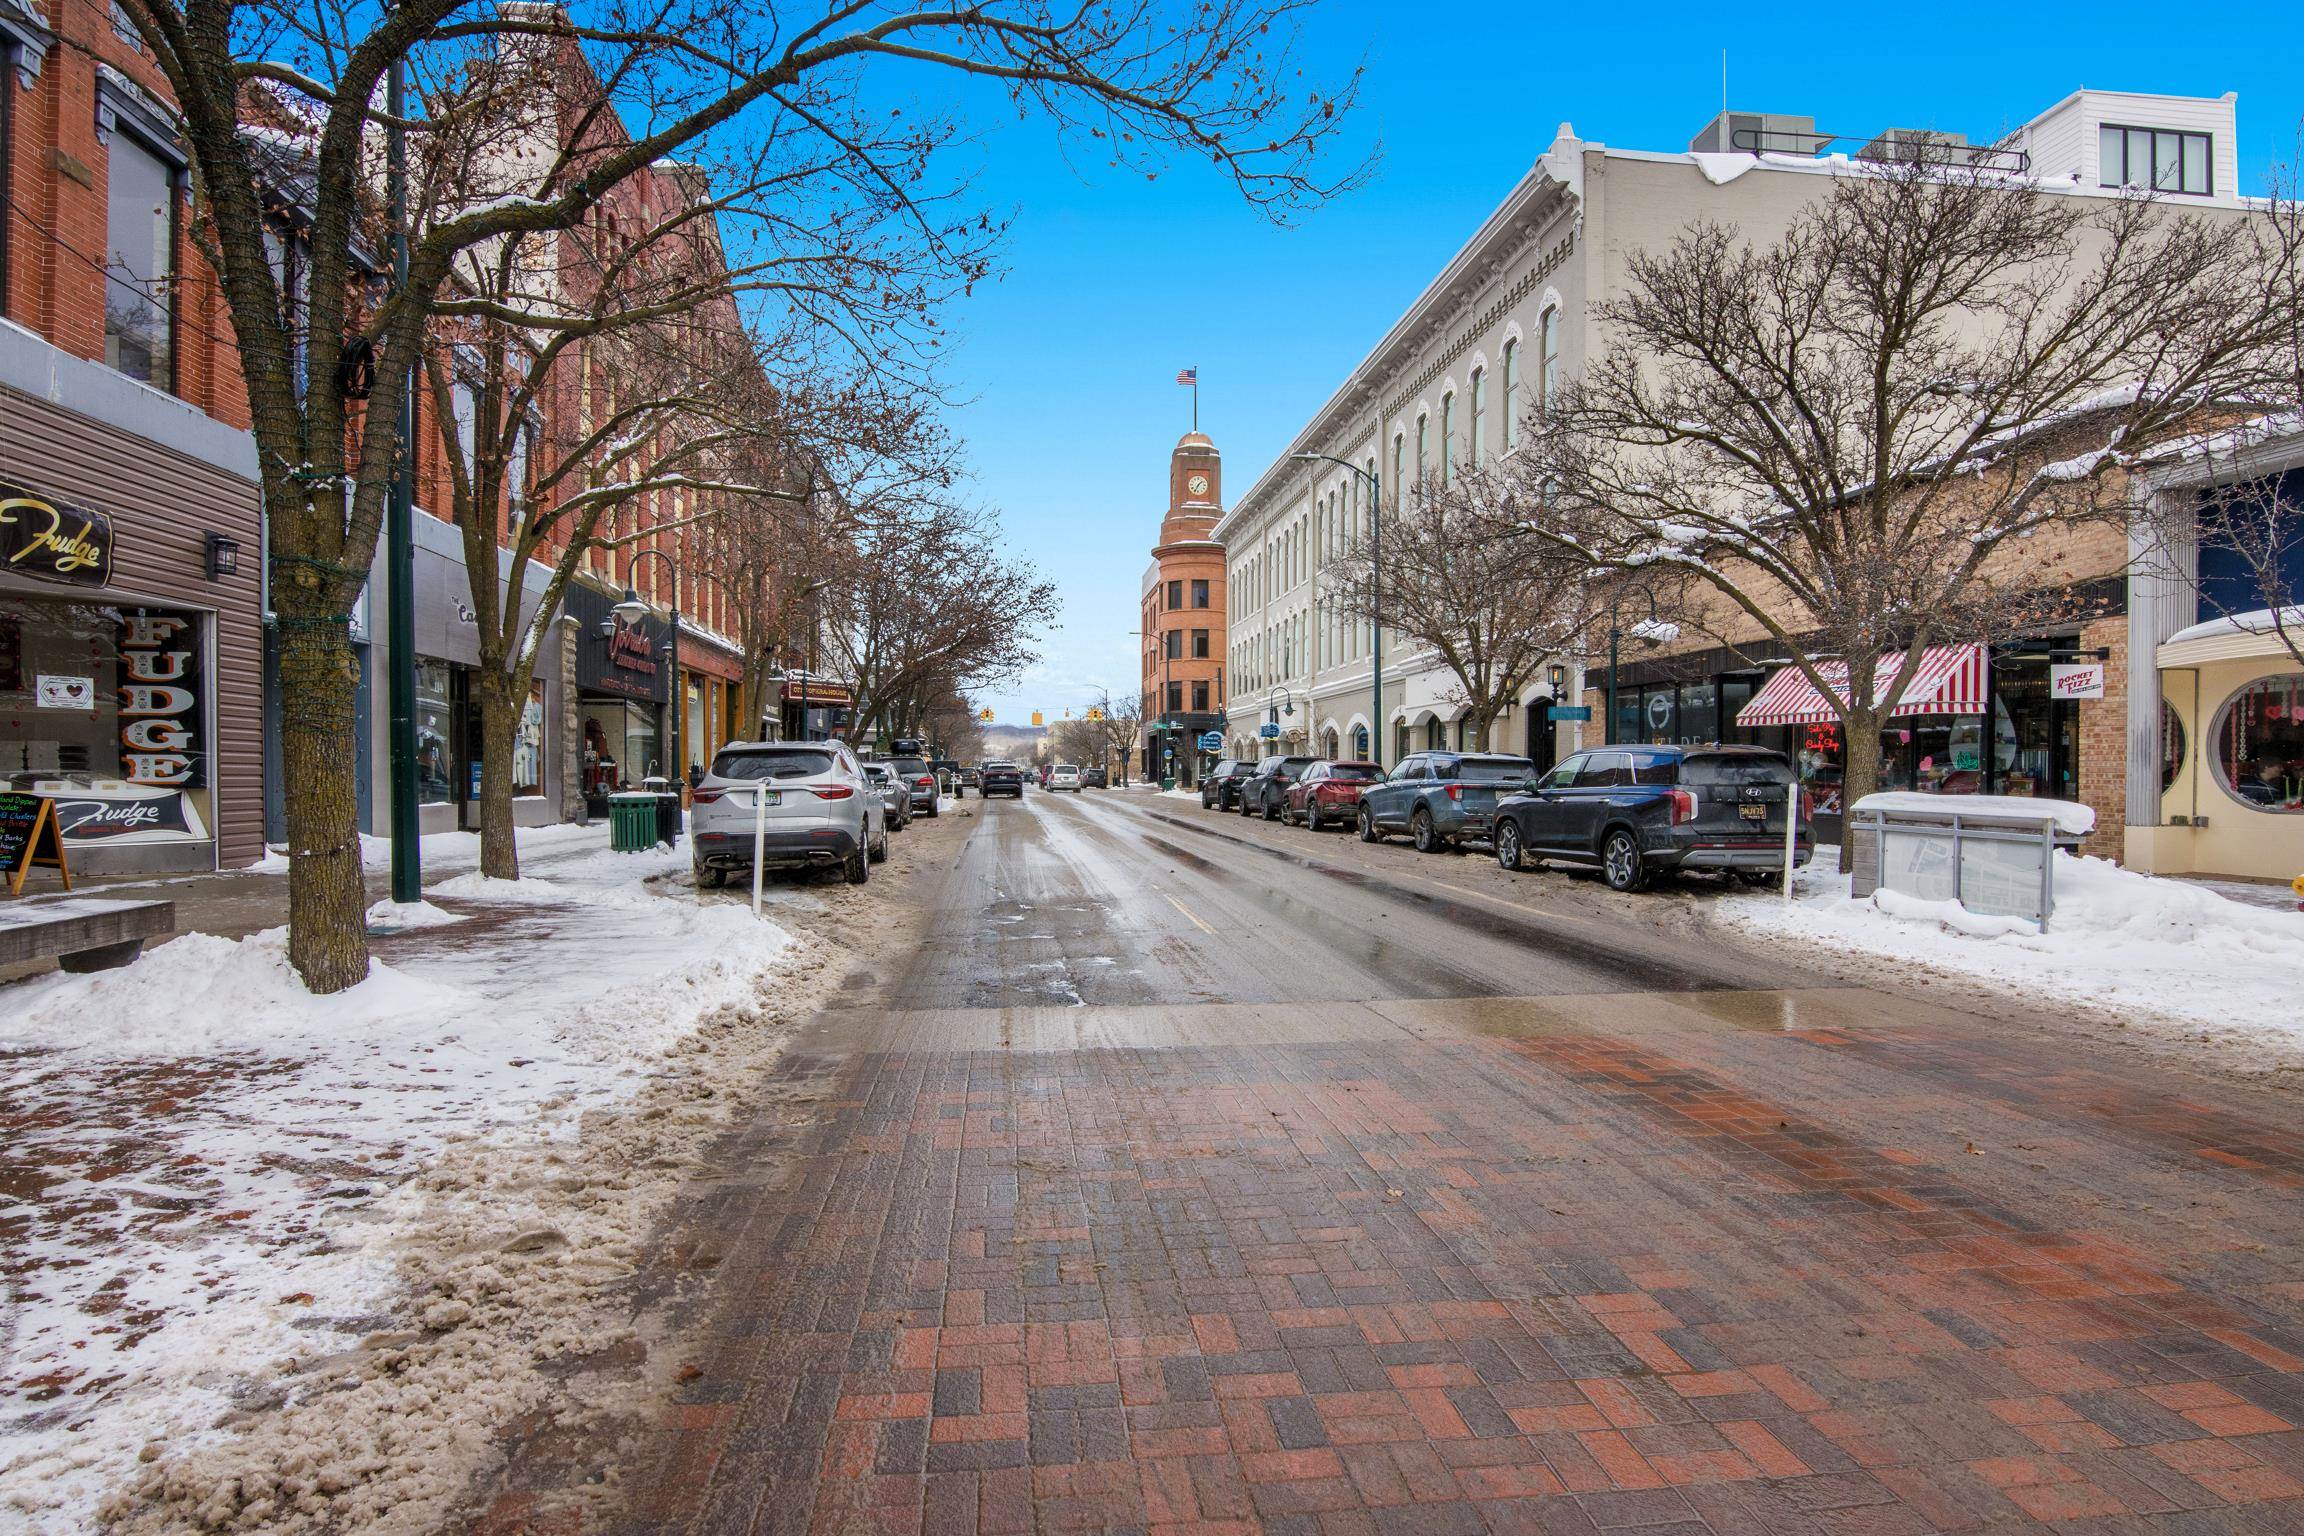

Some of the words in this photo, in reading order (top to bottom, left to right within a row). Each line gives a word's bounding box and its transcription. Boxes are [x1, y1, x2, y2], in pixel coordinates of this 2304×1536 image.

[2056, 671, 2094, 690] ROCKET
[2064, 677, 2092, 694] FIZZ
[118, 617, 194, 784] FUDGE
[828, 689, 847, 697] HOUSE
